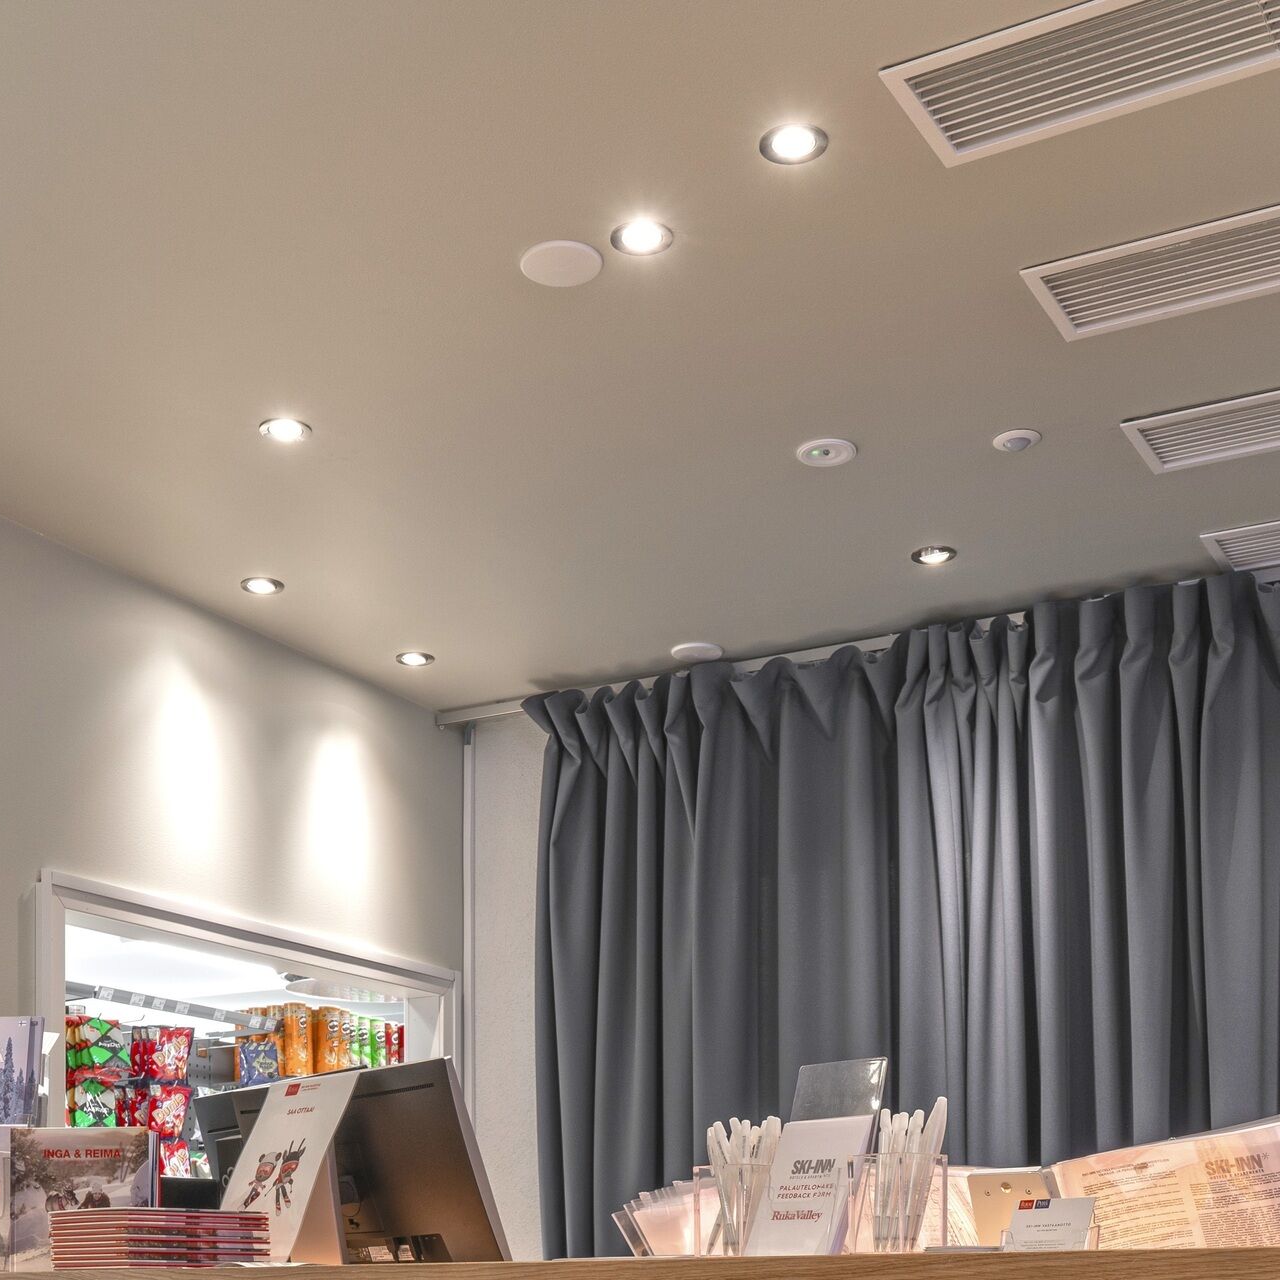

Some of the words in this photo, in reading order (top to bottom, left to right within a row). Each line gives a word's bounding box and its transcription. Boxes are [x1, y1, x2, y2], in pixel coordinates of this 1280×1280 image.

[43, 1149, 71, 1159] INGA
[73, 1149, 81, 1159] &
[85, 1148, 121, 1159] REIMA
[791, 1158, 836, 1175] SKI-INN
[1204, 1153, 1264, 1176] SKI-INN
